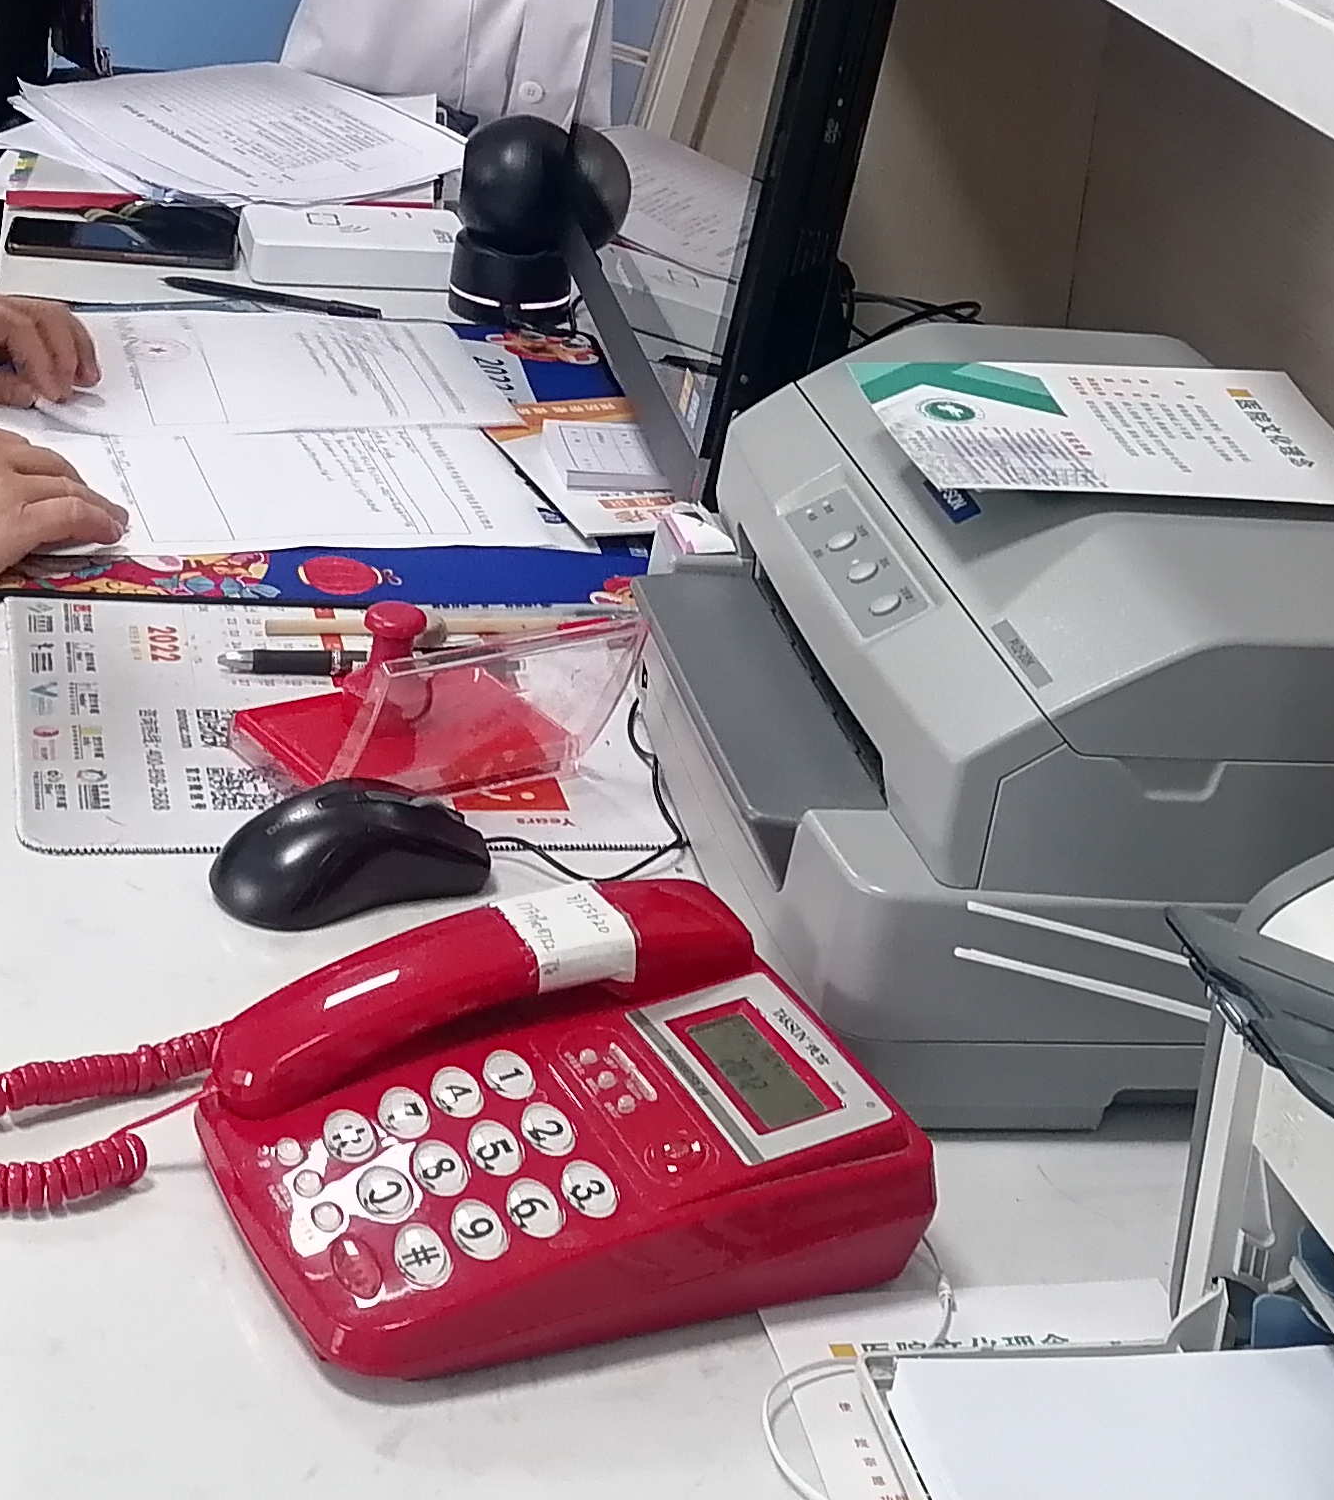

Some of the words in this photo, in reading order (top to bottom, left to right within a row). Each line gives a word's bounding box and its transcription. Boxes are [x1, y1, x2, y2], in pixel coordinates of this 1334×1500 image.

[147, 626, 182, 662] 2022
[498, 1066, 524, 1082] 1
[528, 1119, 564, 1143] 2
[570, 1178, 606, 1204] 3
[421, 1157, 456, 1180] 8
[458, 1219, 494, 1239] 9
[477, 1139, 512, 1167] 5
[511, 1196, 549, 1221] 6
